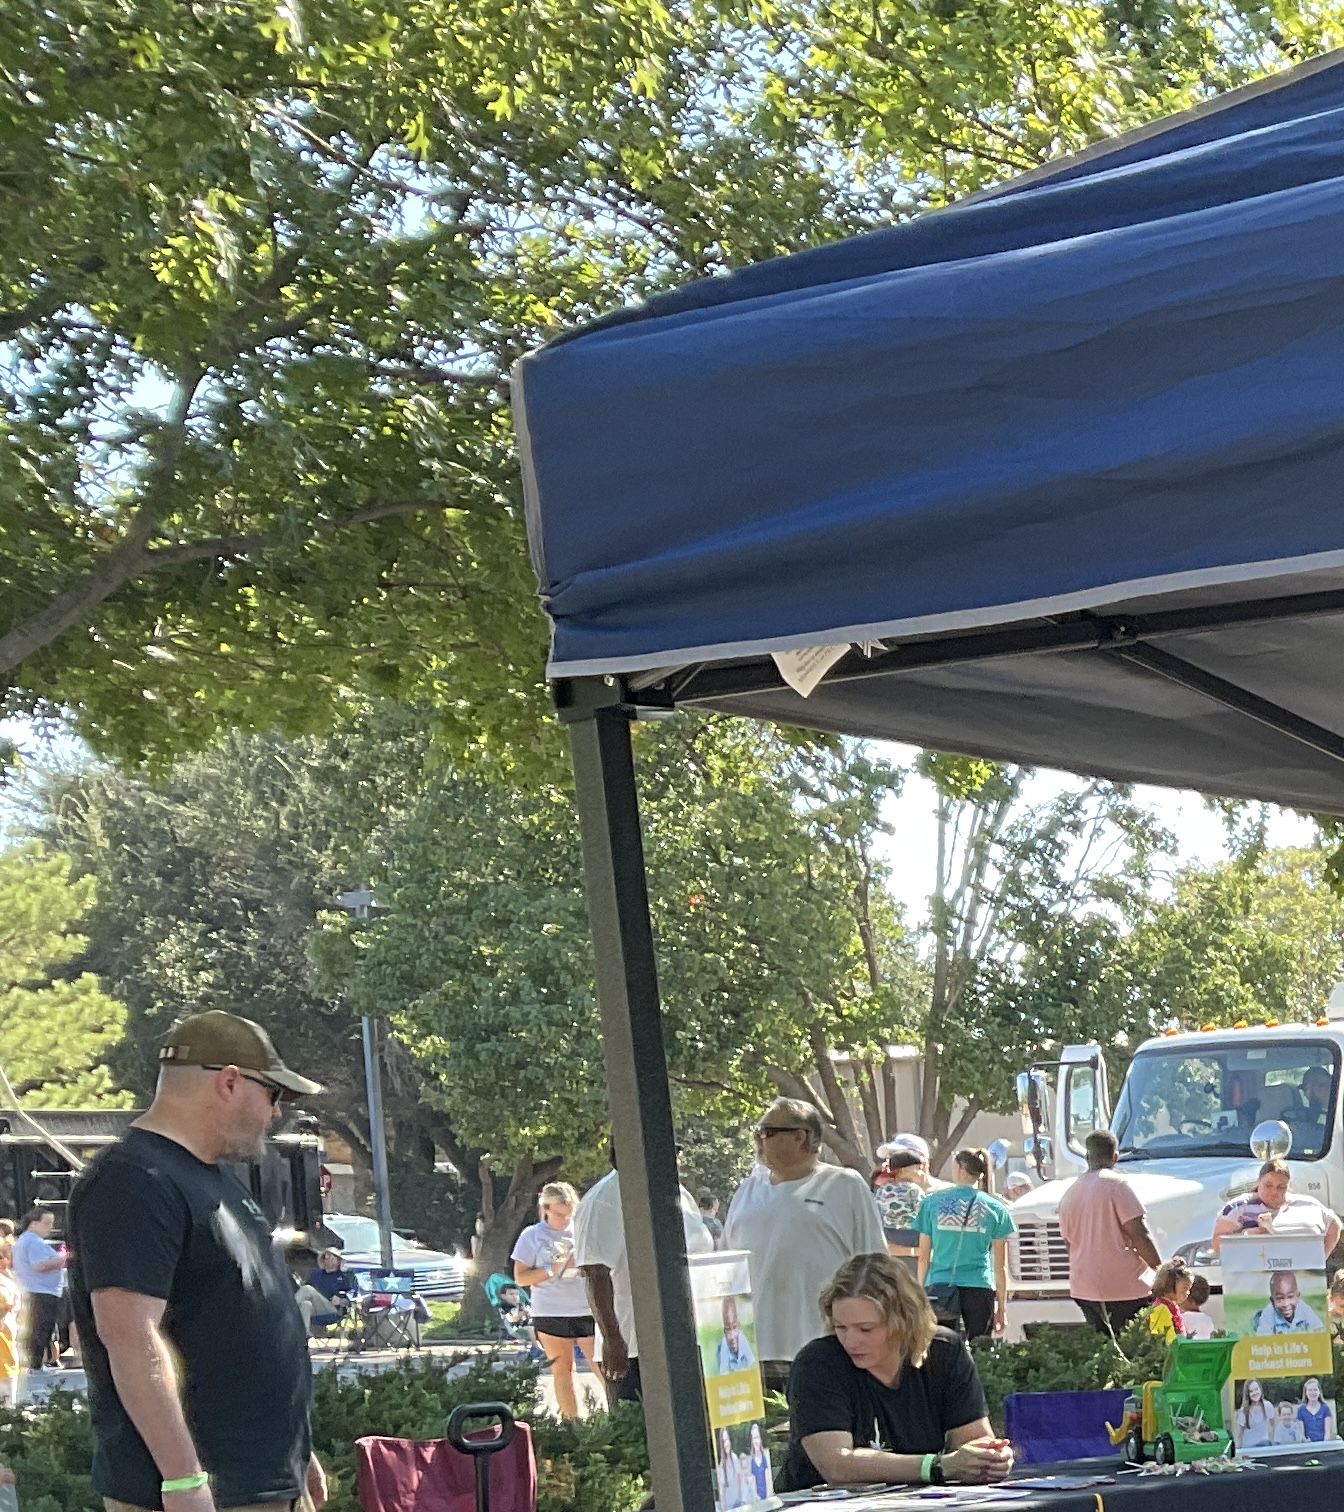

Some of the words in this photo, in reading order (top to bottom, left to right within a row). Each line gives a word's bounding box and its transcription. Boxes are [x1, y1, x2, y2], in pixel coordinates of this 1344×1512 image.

[1267, 1258, 1292, 1269] STARRY
[1250, 1345, 1271, 1356] Help
[1284, 1342, 1308, 1354] Life's
[1249, 1358, 1283, 1371] Darkest
[1286, 1358, 1312, 1368] Hours
